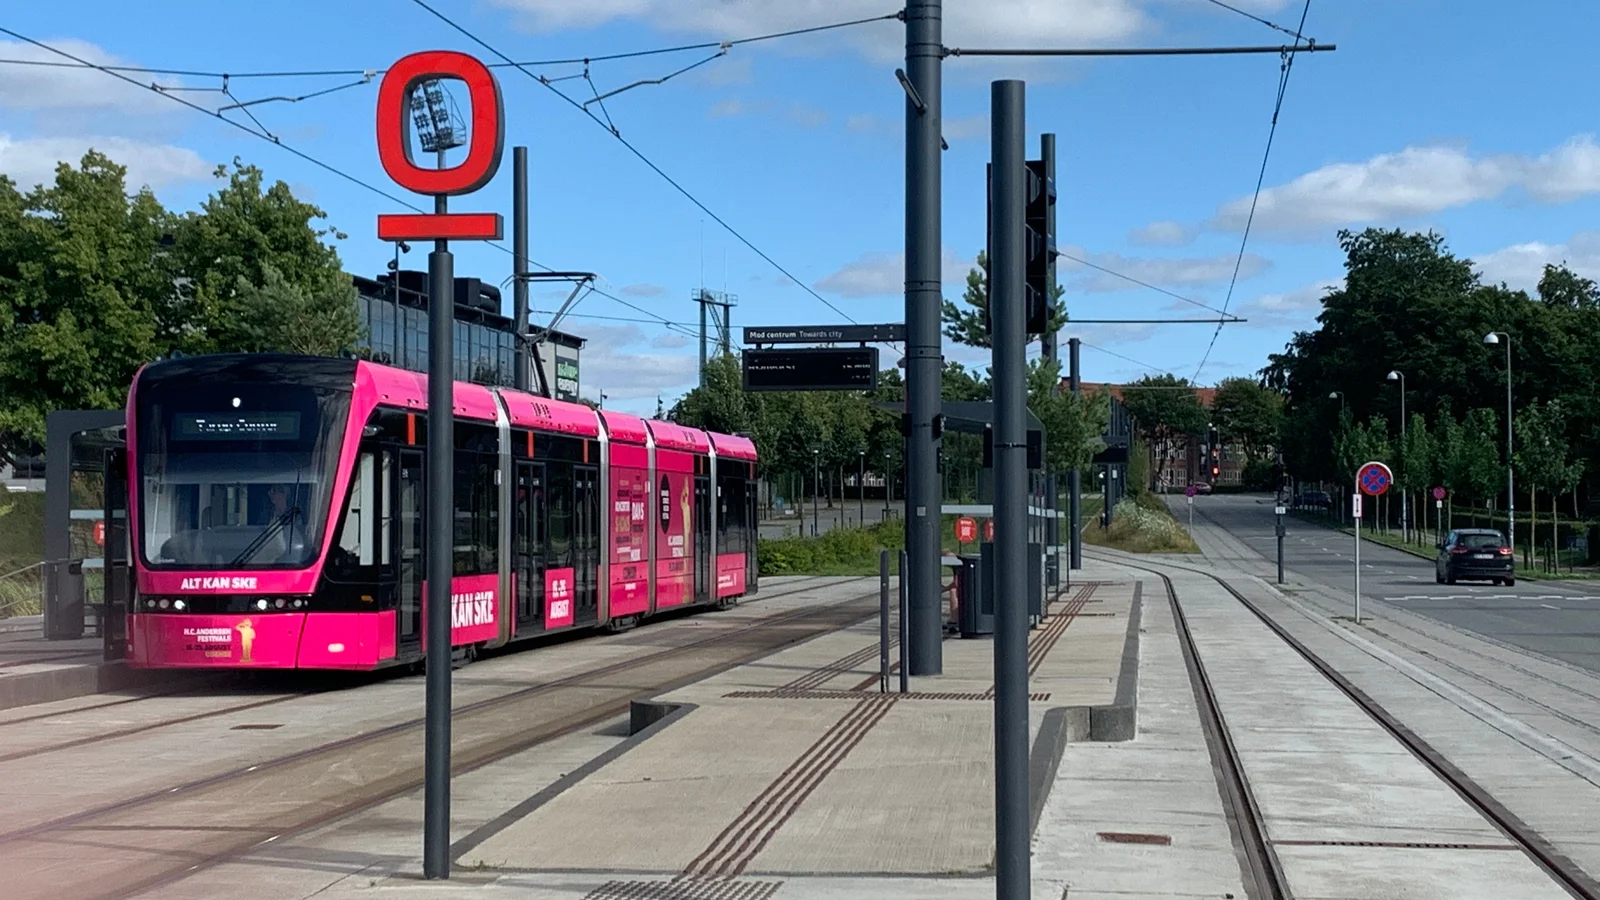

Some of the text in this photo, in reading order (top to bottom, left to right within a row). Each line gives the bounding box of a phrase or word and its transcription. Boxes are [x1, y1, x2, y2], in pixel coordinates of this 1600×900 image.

[799, 330, 827, 338] Towards
[181, 577, 258, 589] ALT KAN SKE
[451, 590, 494, 629] KAN SKE
[197, 635, 232, 643] FESTIVALS
